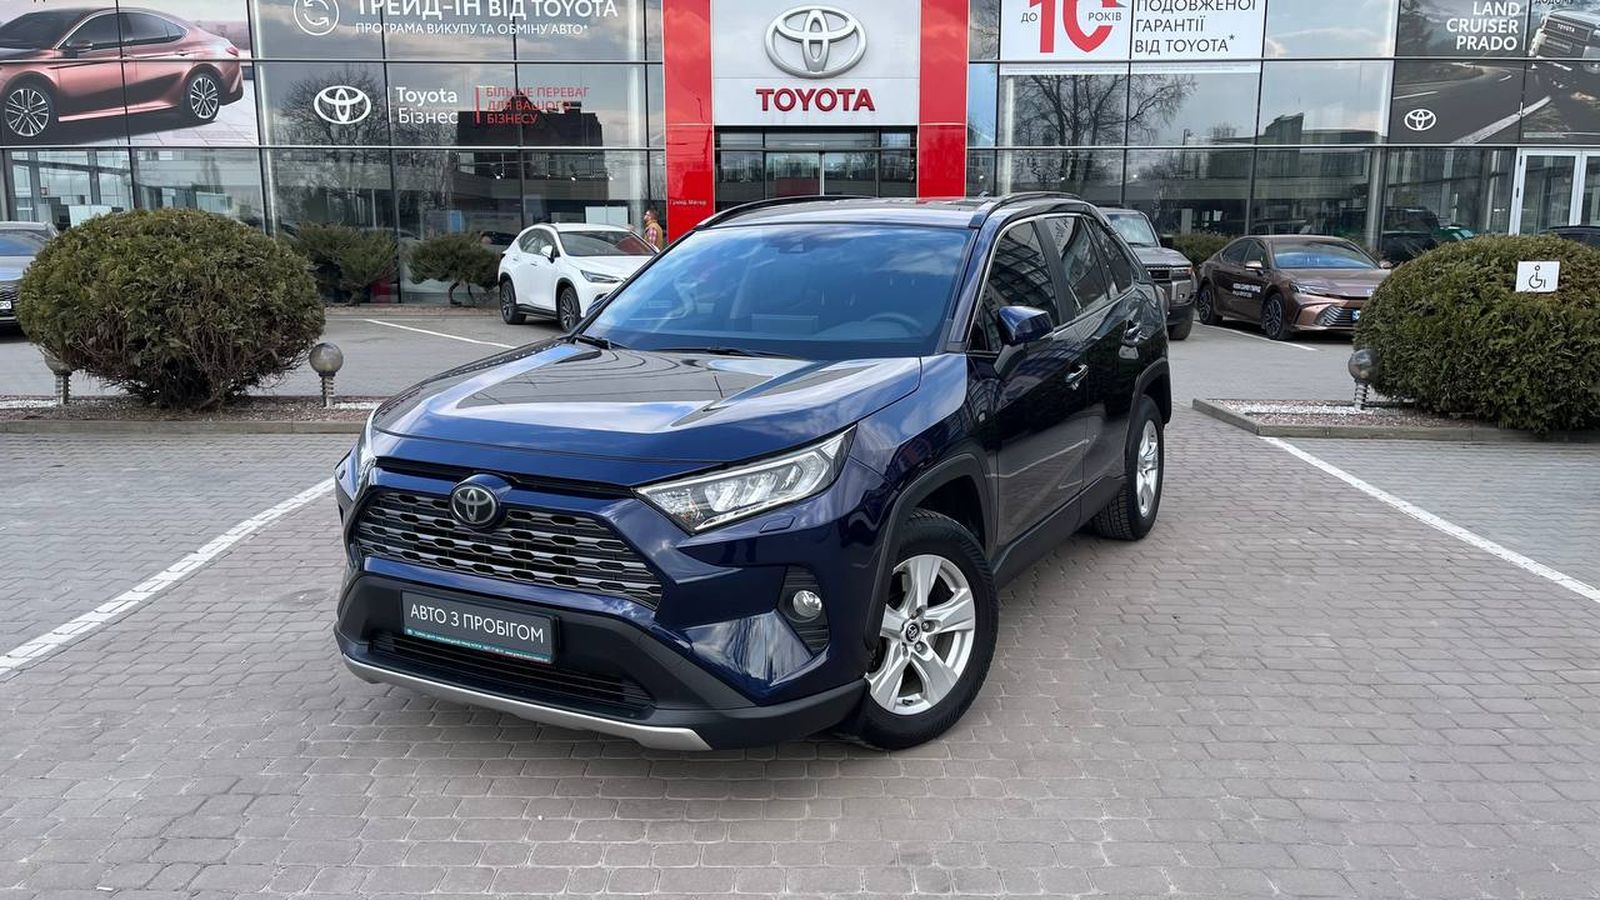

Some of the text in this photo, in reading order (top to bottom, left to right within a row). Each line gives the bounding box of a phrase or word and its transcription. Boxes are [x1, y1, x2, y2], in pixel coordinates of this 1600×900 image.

[532, 0, 619, 17] TOYOTA
[1473, 1, 1521, 16] LAND
[1021, 12, 1038, 23] ДО
[1088, 12, 1122, 21] РОКІВ
[1135, 15, 1206, 32] ГАРАНТІЇ
[355, 22, 424, 34] ПРОГРАМА
[427, 23, 477, 34] ВИКУПУ
[480, 24, 495, 34] ТА
[497, 24, 549, 35] ОБМІНУ
[1446, 18, 1519, 34] CRUISER
[1135, 40, 1160, 55] ВІД
[1456, 35, 1518, 51] PRADO
[396, 87, 457, 106] Toyota
[537, 87, 590, 97] ПЕРЕВАГ
[755, 88, 876, 112] TOYOTA
[487, 101, 512, 111] ДЛЯ
[399, 107, 458, 125] Бізнес
[487, 113, 538, 124] БІЗНЕСУ
[410, 603, 544, 644] АВТО З ПРОБІГОМ
